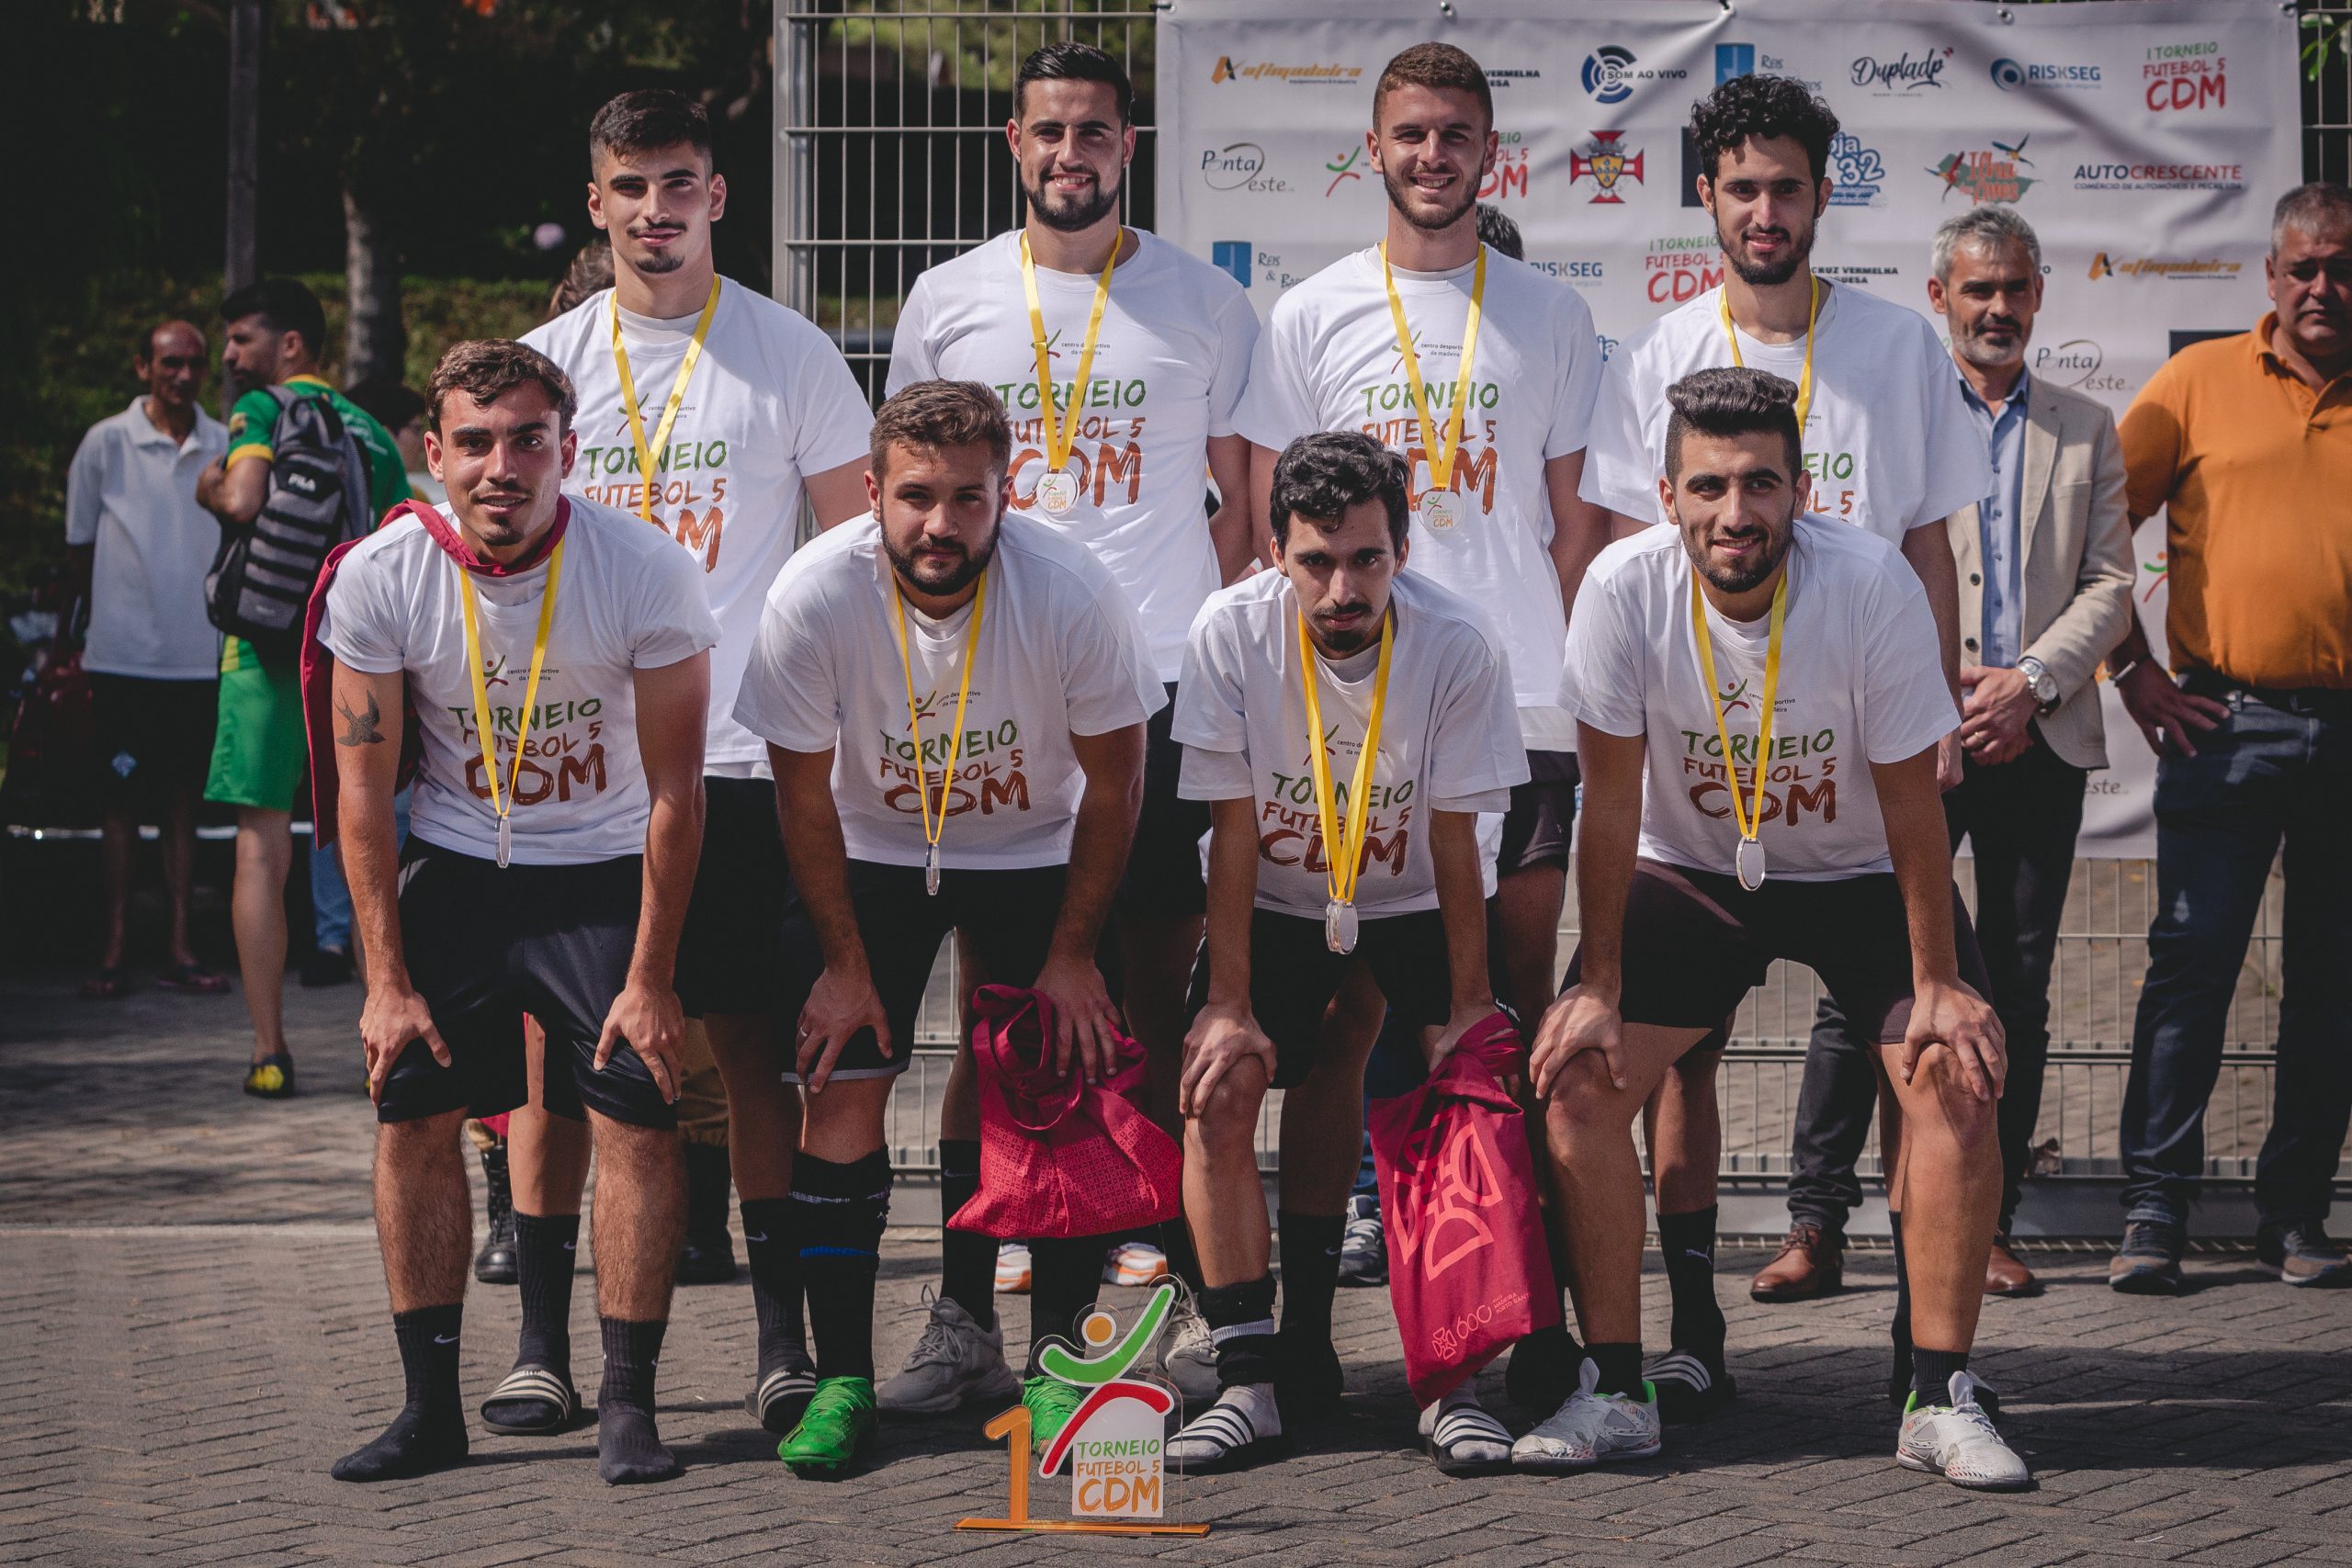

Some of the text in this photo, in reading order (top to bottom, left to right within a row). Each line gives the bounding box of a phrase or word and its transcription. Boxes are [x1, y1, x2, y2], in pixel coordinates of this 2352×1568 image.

[2154, 41, 2218, 59] TORNEIO
[1608, 69, 1687, 79] SOM AO VIVO
[2028, 64, 2101, 81] RISKSEG
[2143, 57, 2226, 79] FUTEBOL 5
[2147, 73, 2226, 111] CDM
[1838, 149, 1885, 185] 32
[2075, 164, 2243, 179] AUTOCRESCENTE
[1645, 253, 1713, 270] FUTEBOL
[1842, 266, 1898, 275] VERMELHA
[1266, 270, 1275, 280] &
[1128, 417, 1146, 438] 5
[1485, 420, 1498, 442] 5
[288, 473, 316, 491] FILA
[712, 478, 727, 502] 5
[1840, 491, 1854, 514] 5
[1433, 518, 1453, 527] CDM
[589, 721, 603, 739] 5
[880, 719, 1018, 765] TORNEIO
[1010, 749, 1023, 768] 5
[1822, 756, 1837, 776] 5
[465, 743, 607, 806] CDM
[884, 770, 1031, 817] CDM
[1689, 779, 1837, 827] CDM
[1398, 806, 1413, 827] 5
[1077, 1438, 1160, 1460] TORNEIO
[1077, 1460, 1161, 1477] FUTEBOL 5
[1079, 1476, 1160, 1513] CDM
